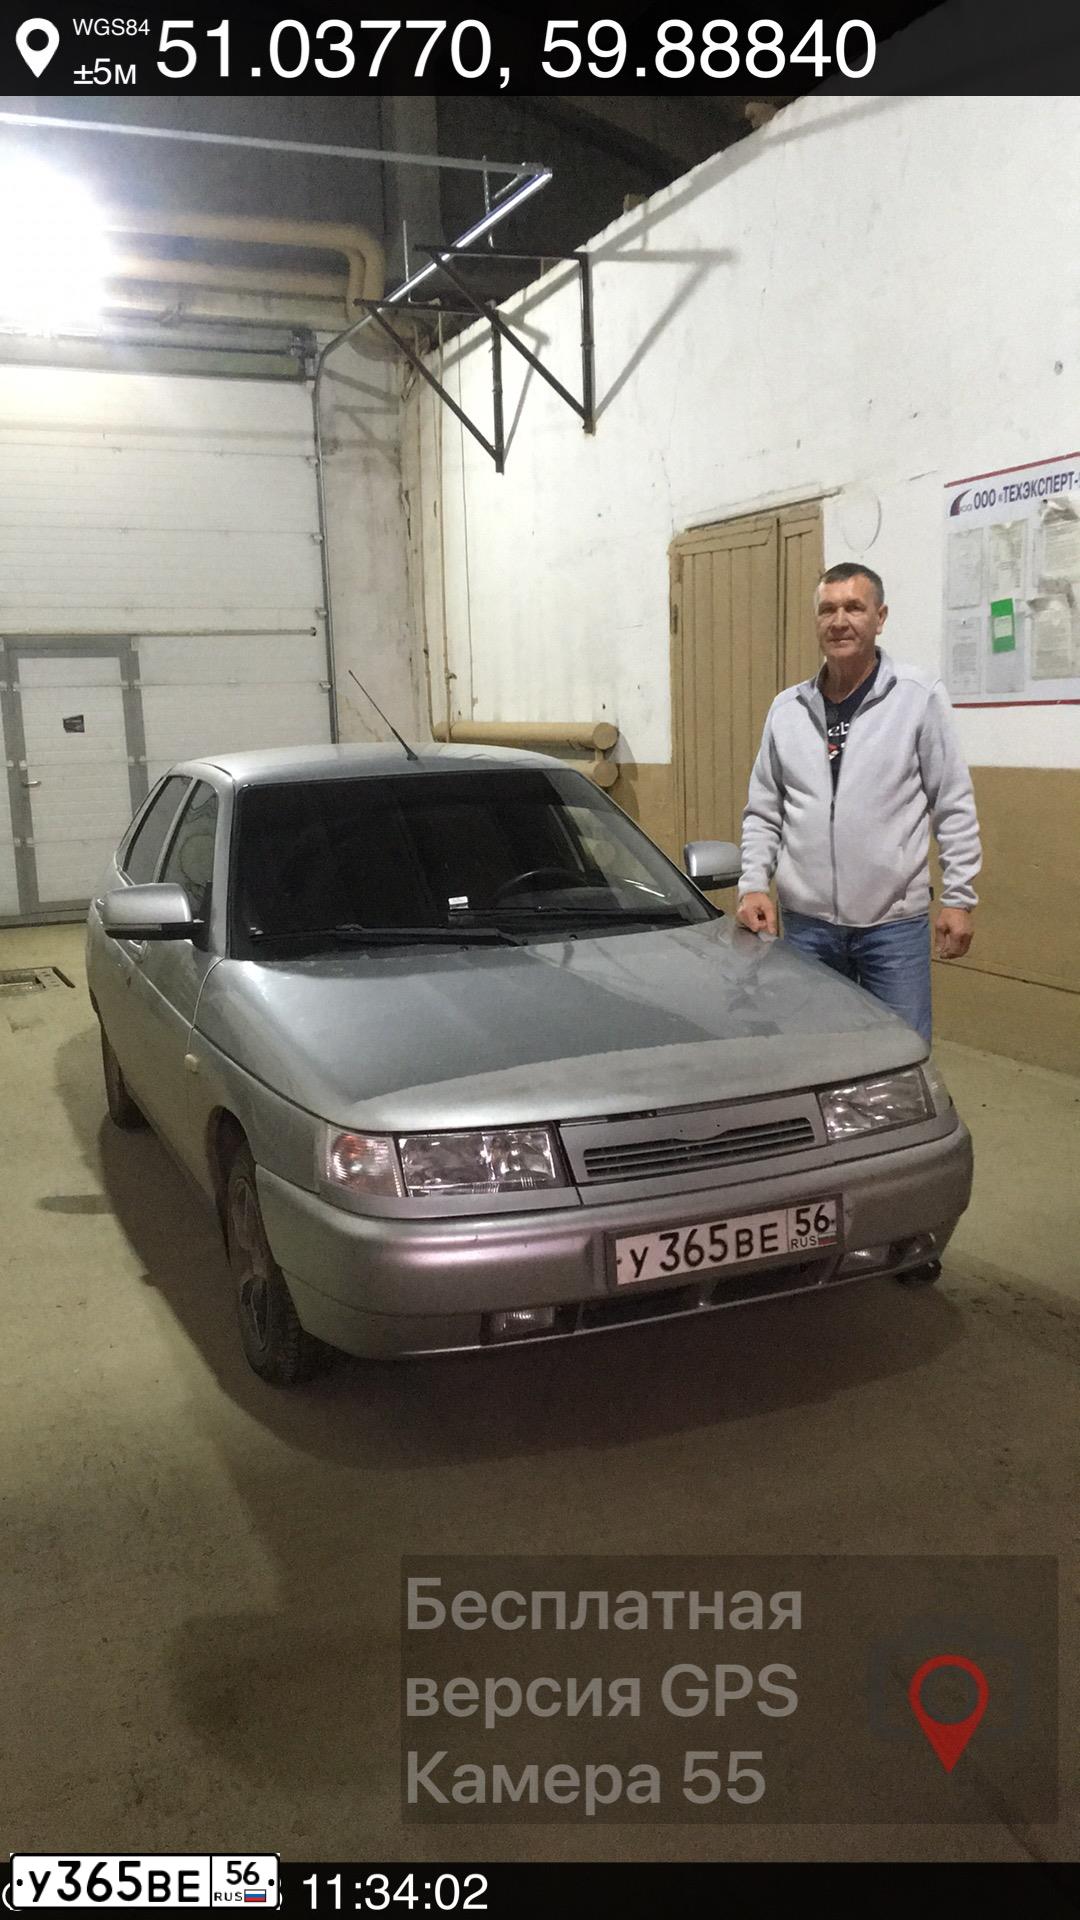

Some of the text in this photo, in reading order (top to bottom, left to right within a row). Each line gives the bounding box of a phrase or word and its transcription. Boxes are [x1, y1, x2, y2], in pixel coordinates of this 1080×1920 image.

[973, 488, 996, 510] ООО
[998, 471, 1080, 503] «ТЕХЭКСПЕРТ-
[795, 1204, 830, 1237] 56
[790, 1236, 817, 1249] RUS
